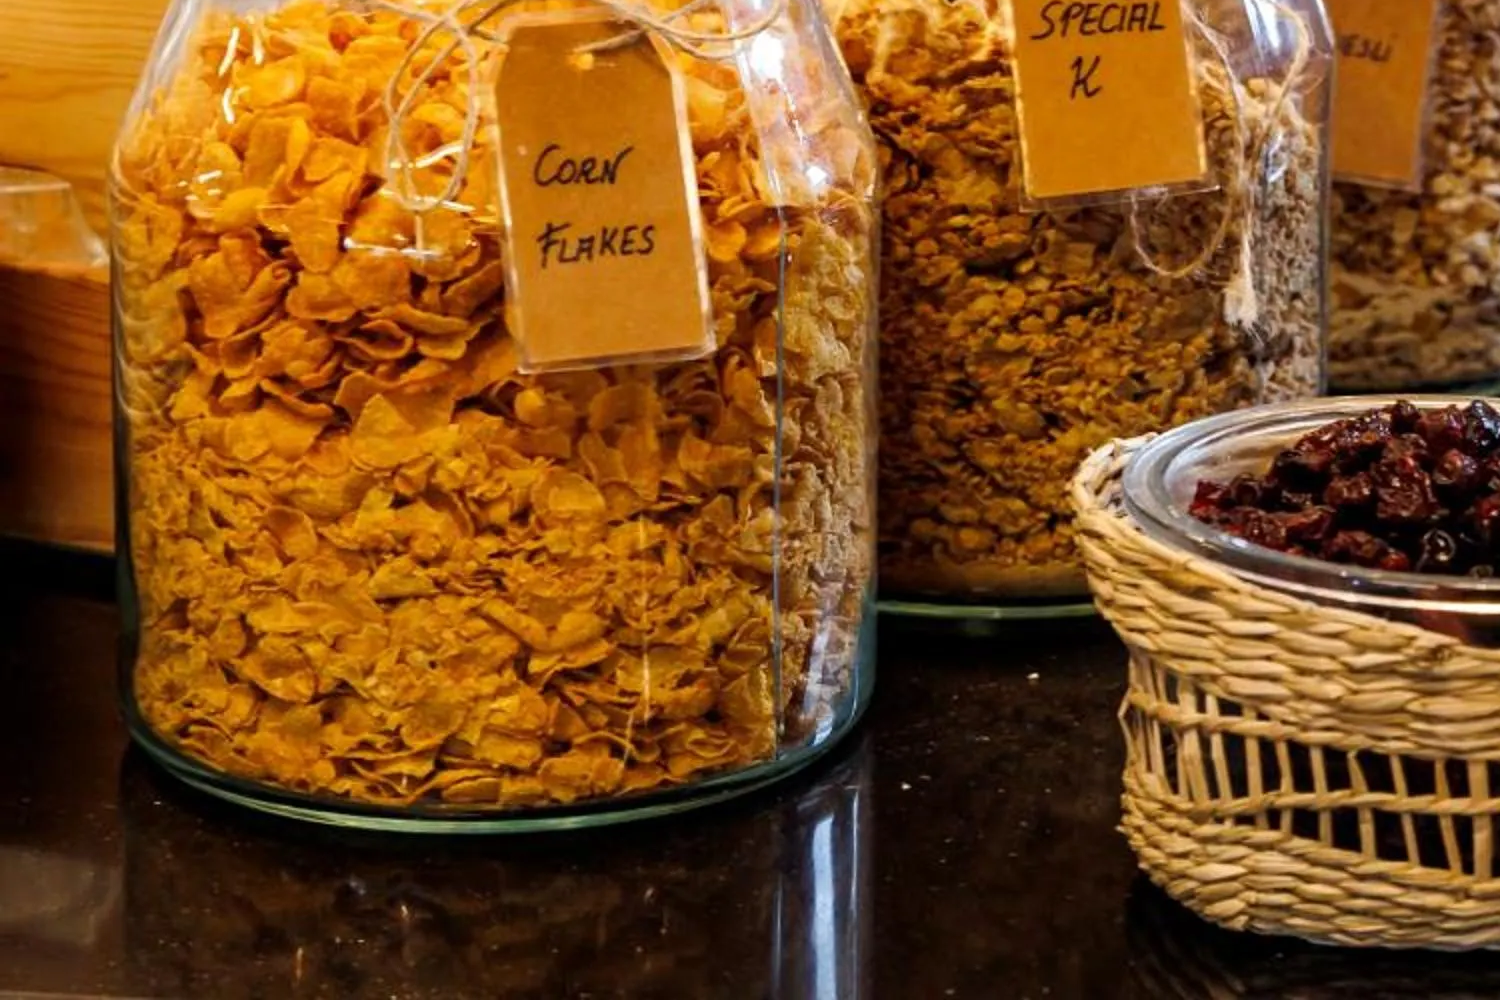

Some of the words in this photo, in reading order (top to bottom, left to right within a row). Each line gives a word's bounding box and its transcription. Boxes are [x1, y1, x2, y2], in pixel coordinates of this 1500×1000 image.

[1337, 32, 1400, 62] ESLI
[1069, 56, 1103, 101] K
[533, 144, 635, 187] CORN
[535, 222, 656, 270] FLAKES
